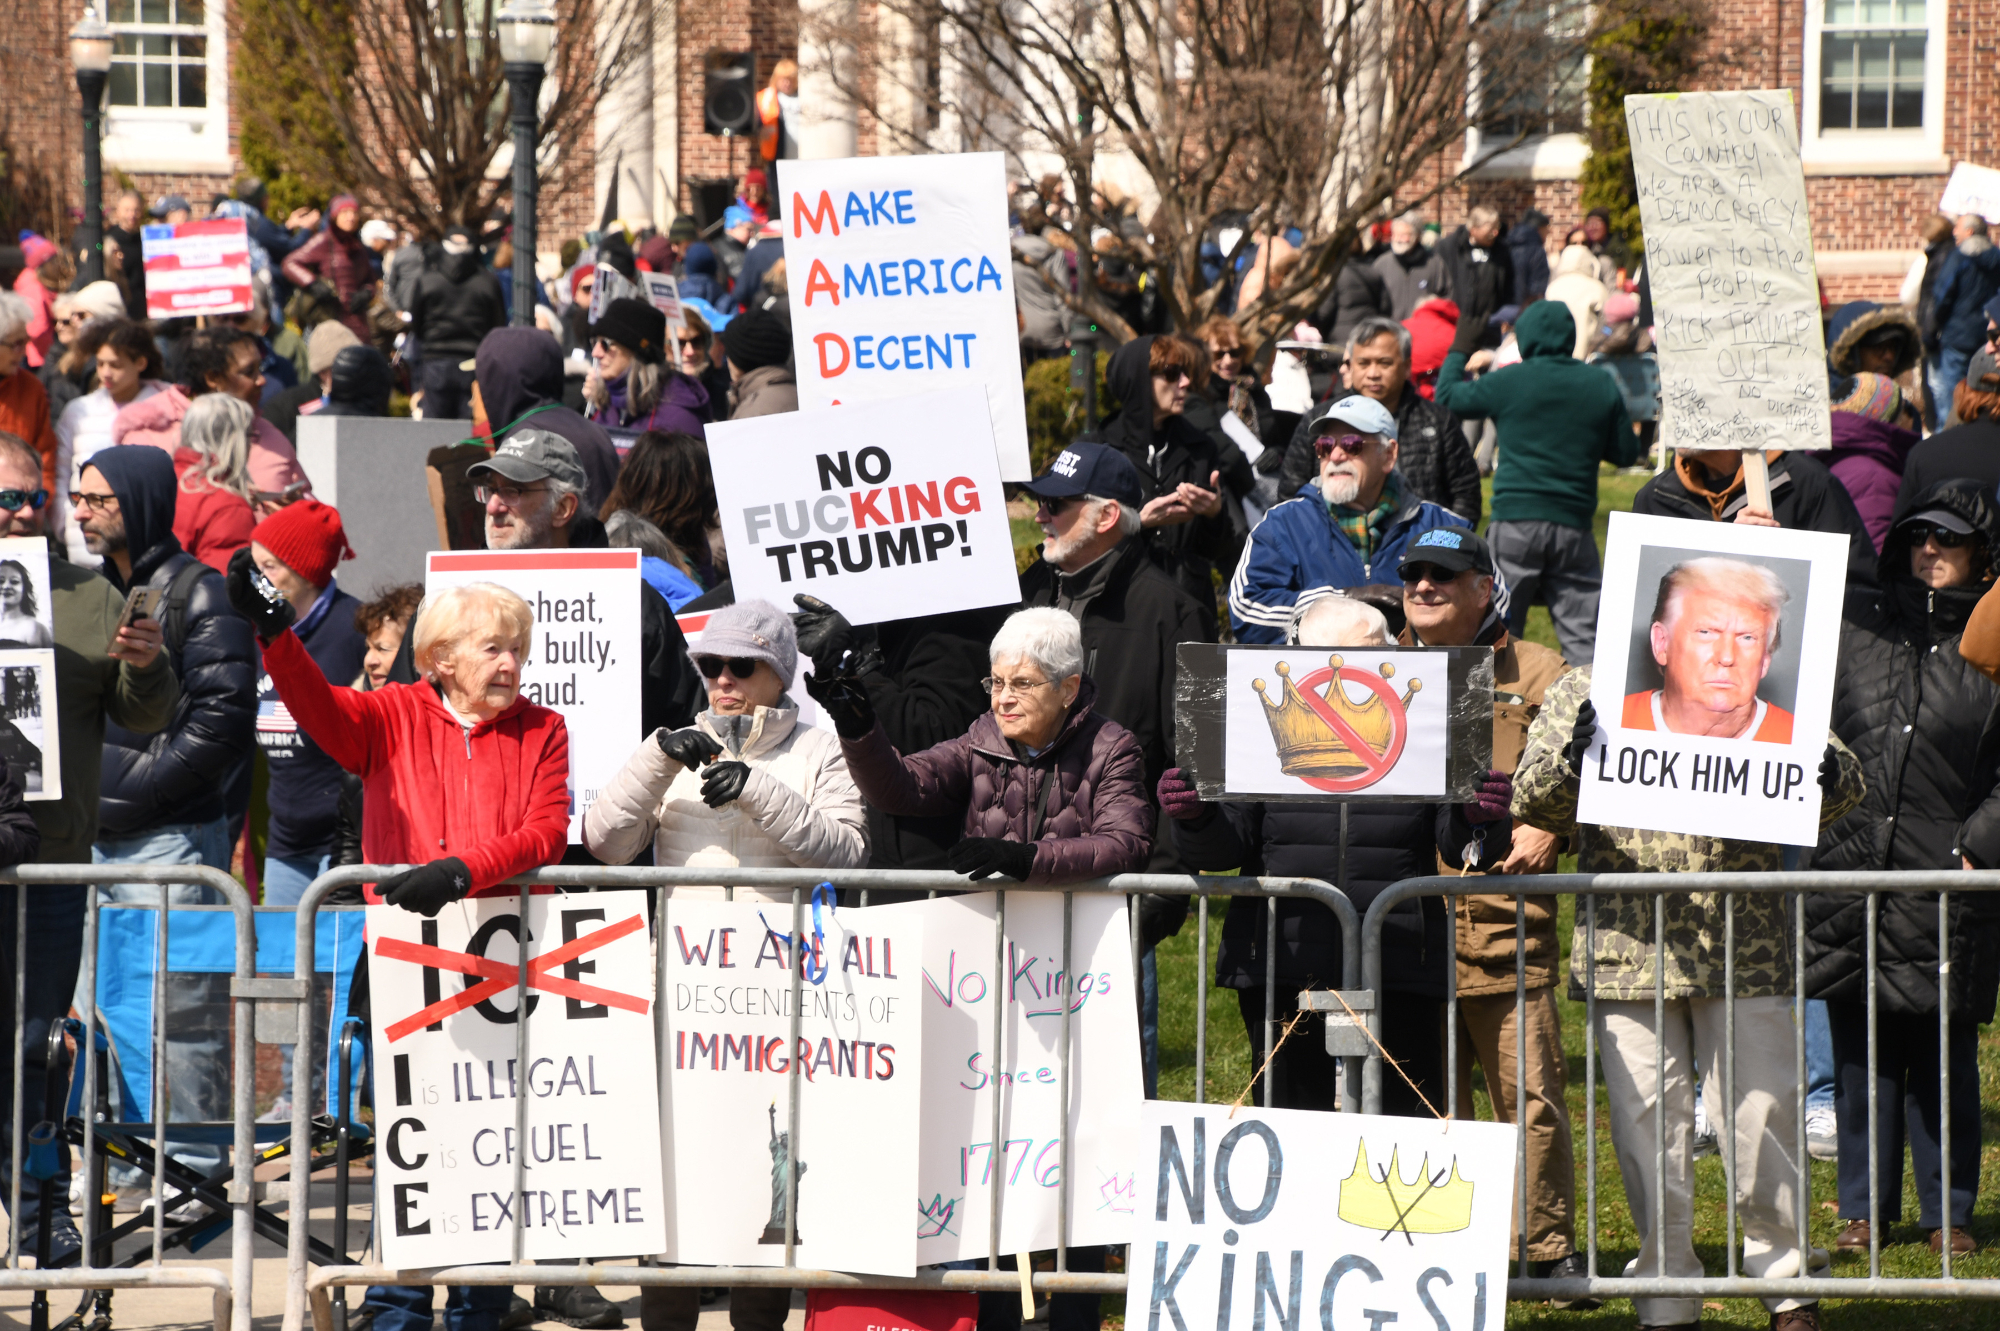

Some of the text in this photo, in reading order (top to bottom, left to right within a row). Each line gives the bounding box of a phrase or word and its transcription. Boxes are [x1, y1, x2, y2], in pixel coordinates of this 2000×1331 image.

[1629, 106, 1786, 143] THIS IS OUR
[1638, 172, 1674, 197] We
[1738, 172, 1756, 197] A
[793, 189, 916, 239] MAKE
[1655, 197, 1798, 235] DEMOCRACY
[1726, 238, 1752, 267] to
[1757, 237, 1808, 275] the
[804, 255, 1002, 307] AMERICA
[1663, 309, 1811, 346] KICK TRUMP
[813, 332, 977, 379] DECENT
[1739, 384, 1761, 399] NO
[1794, 383, 1816, 400] NO
[815, 446, 892, 491] NO
[743, 476, 981, 545] FUCKING
[765, 519, 972, 583] TRUMP!
[527, 590, 603, 624] heat,
[545, 631, 616, 673] bully,
[519, 673, 584, 706] raud.
[1598, 744, 1804, 802] LOCK HIM UP.
[421, 908, 609, 1032] ICE
[674, 925, 737, 969] WE
[842, 935, 898, 979] ALL
[1009, 941, 1111, 1018] Kings
[869, 996, 899, 1023] OF
[394, 1054, 607, 1106] I is ILLEGAL
[676, 1031, 896, 1083] IMMIGRANTS
[960, 1052, 1057, 1090] Since
[386, 1117, 602, 1171] C is CRUEL
[960, 1139, 1061, 1187] 1776
[1155, 1117, 1284, 1226] NO
[393, 1181, 644, 1238] E is EXTREME
